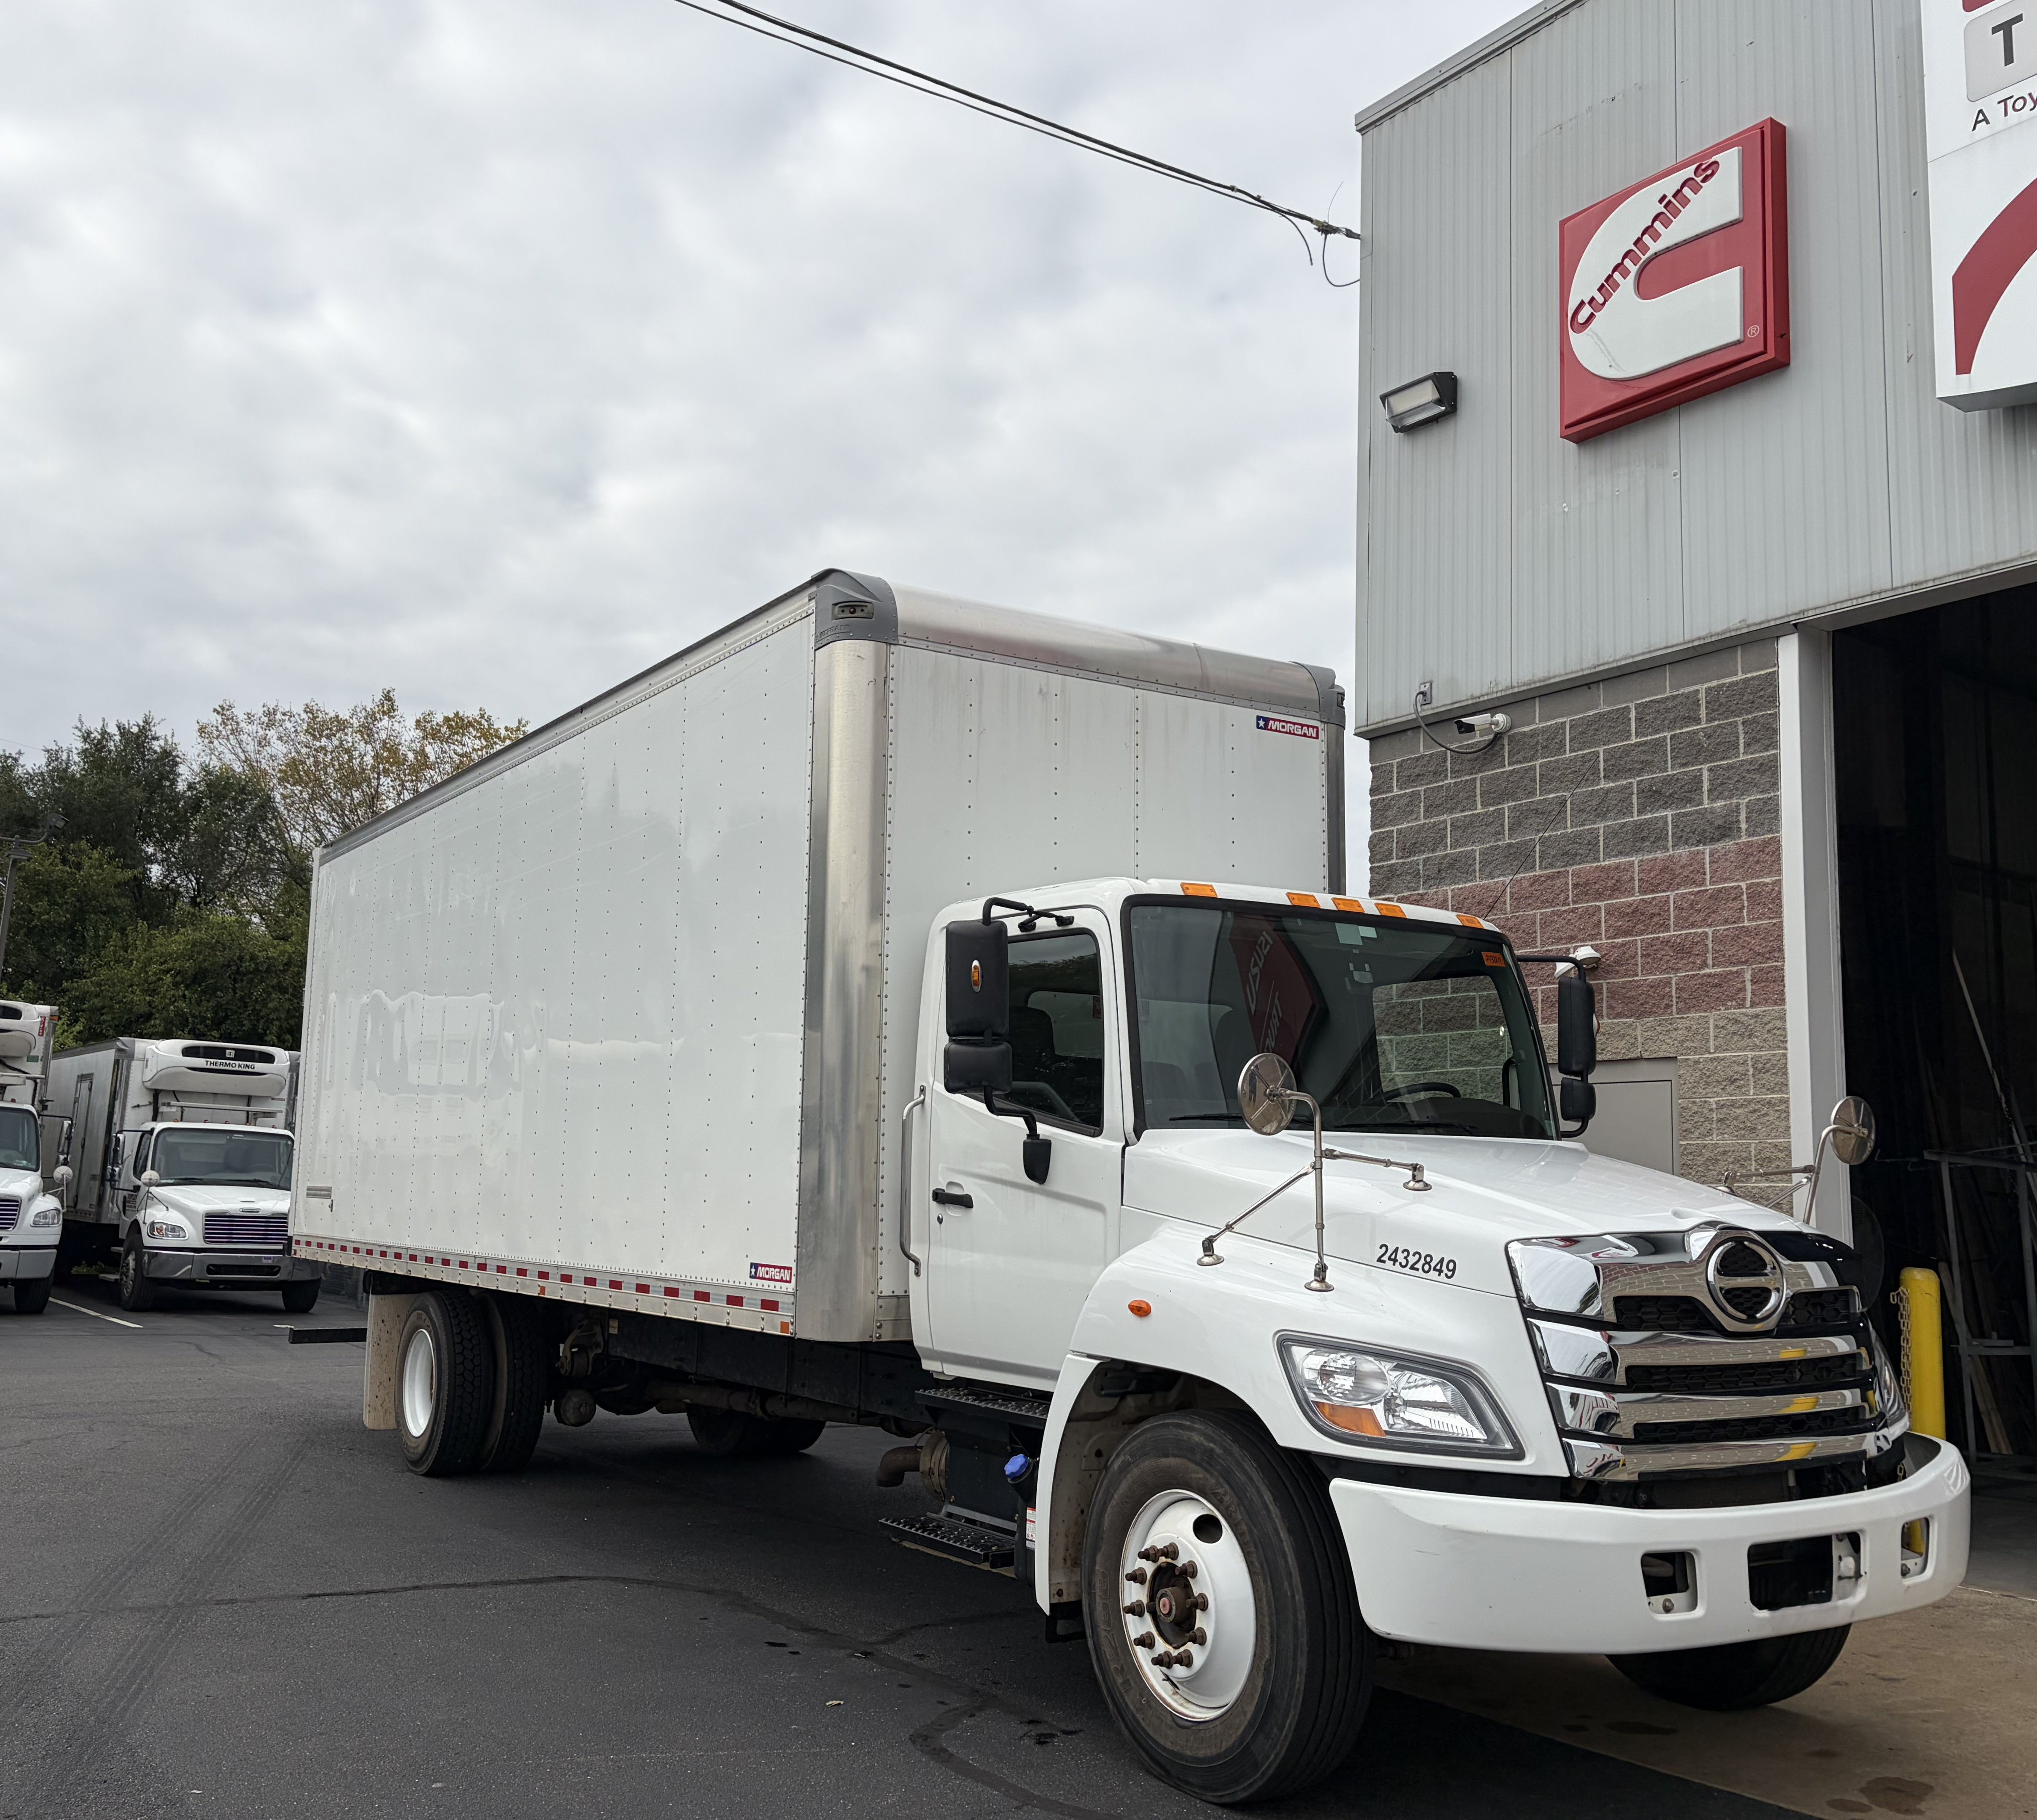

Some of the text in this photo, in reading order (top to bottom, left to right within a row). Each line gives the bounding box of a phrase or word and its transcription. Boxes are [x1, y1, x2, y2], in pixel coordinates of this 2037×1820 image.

[1972, 108, 1991, 132] A
[1569, 160, 1720, 335] Cummins
[1268, 720, 1316, 738] MORGAN
[205, 1060, 237, 1069] THERMO
[1376, 1243, 1457, 1279] 2432849
[756, 1266, 791, 1281] MORGAN
